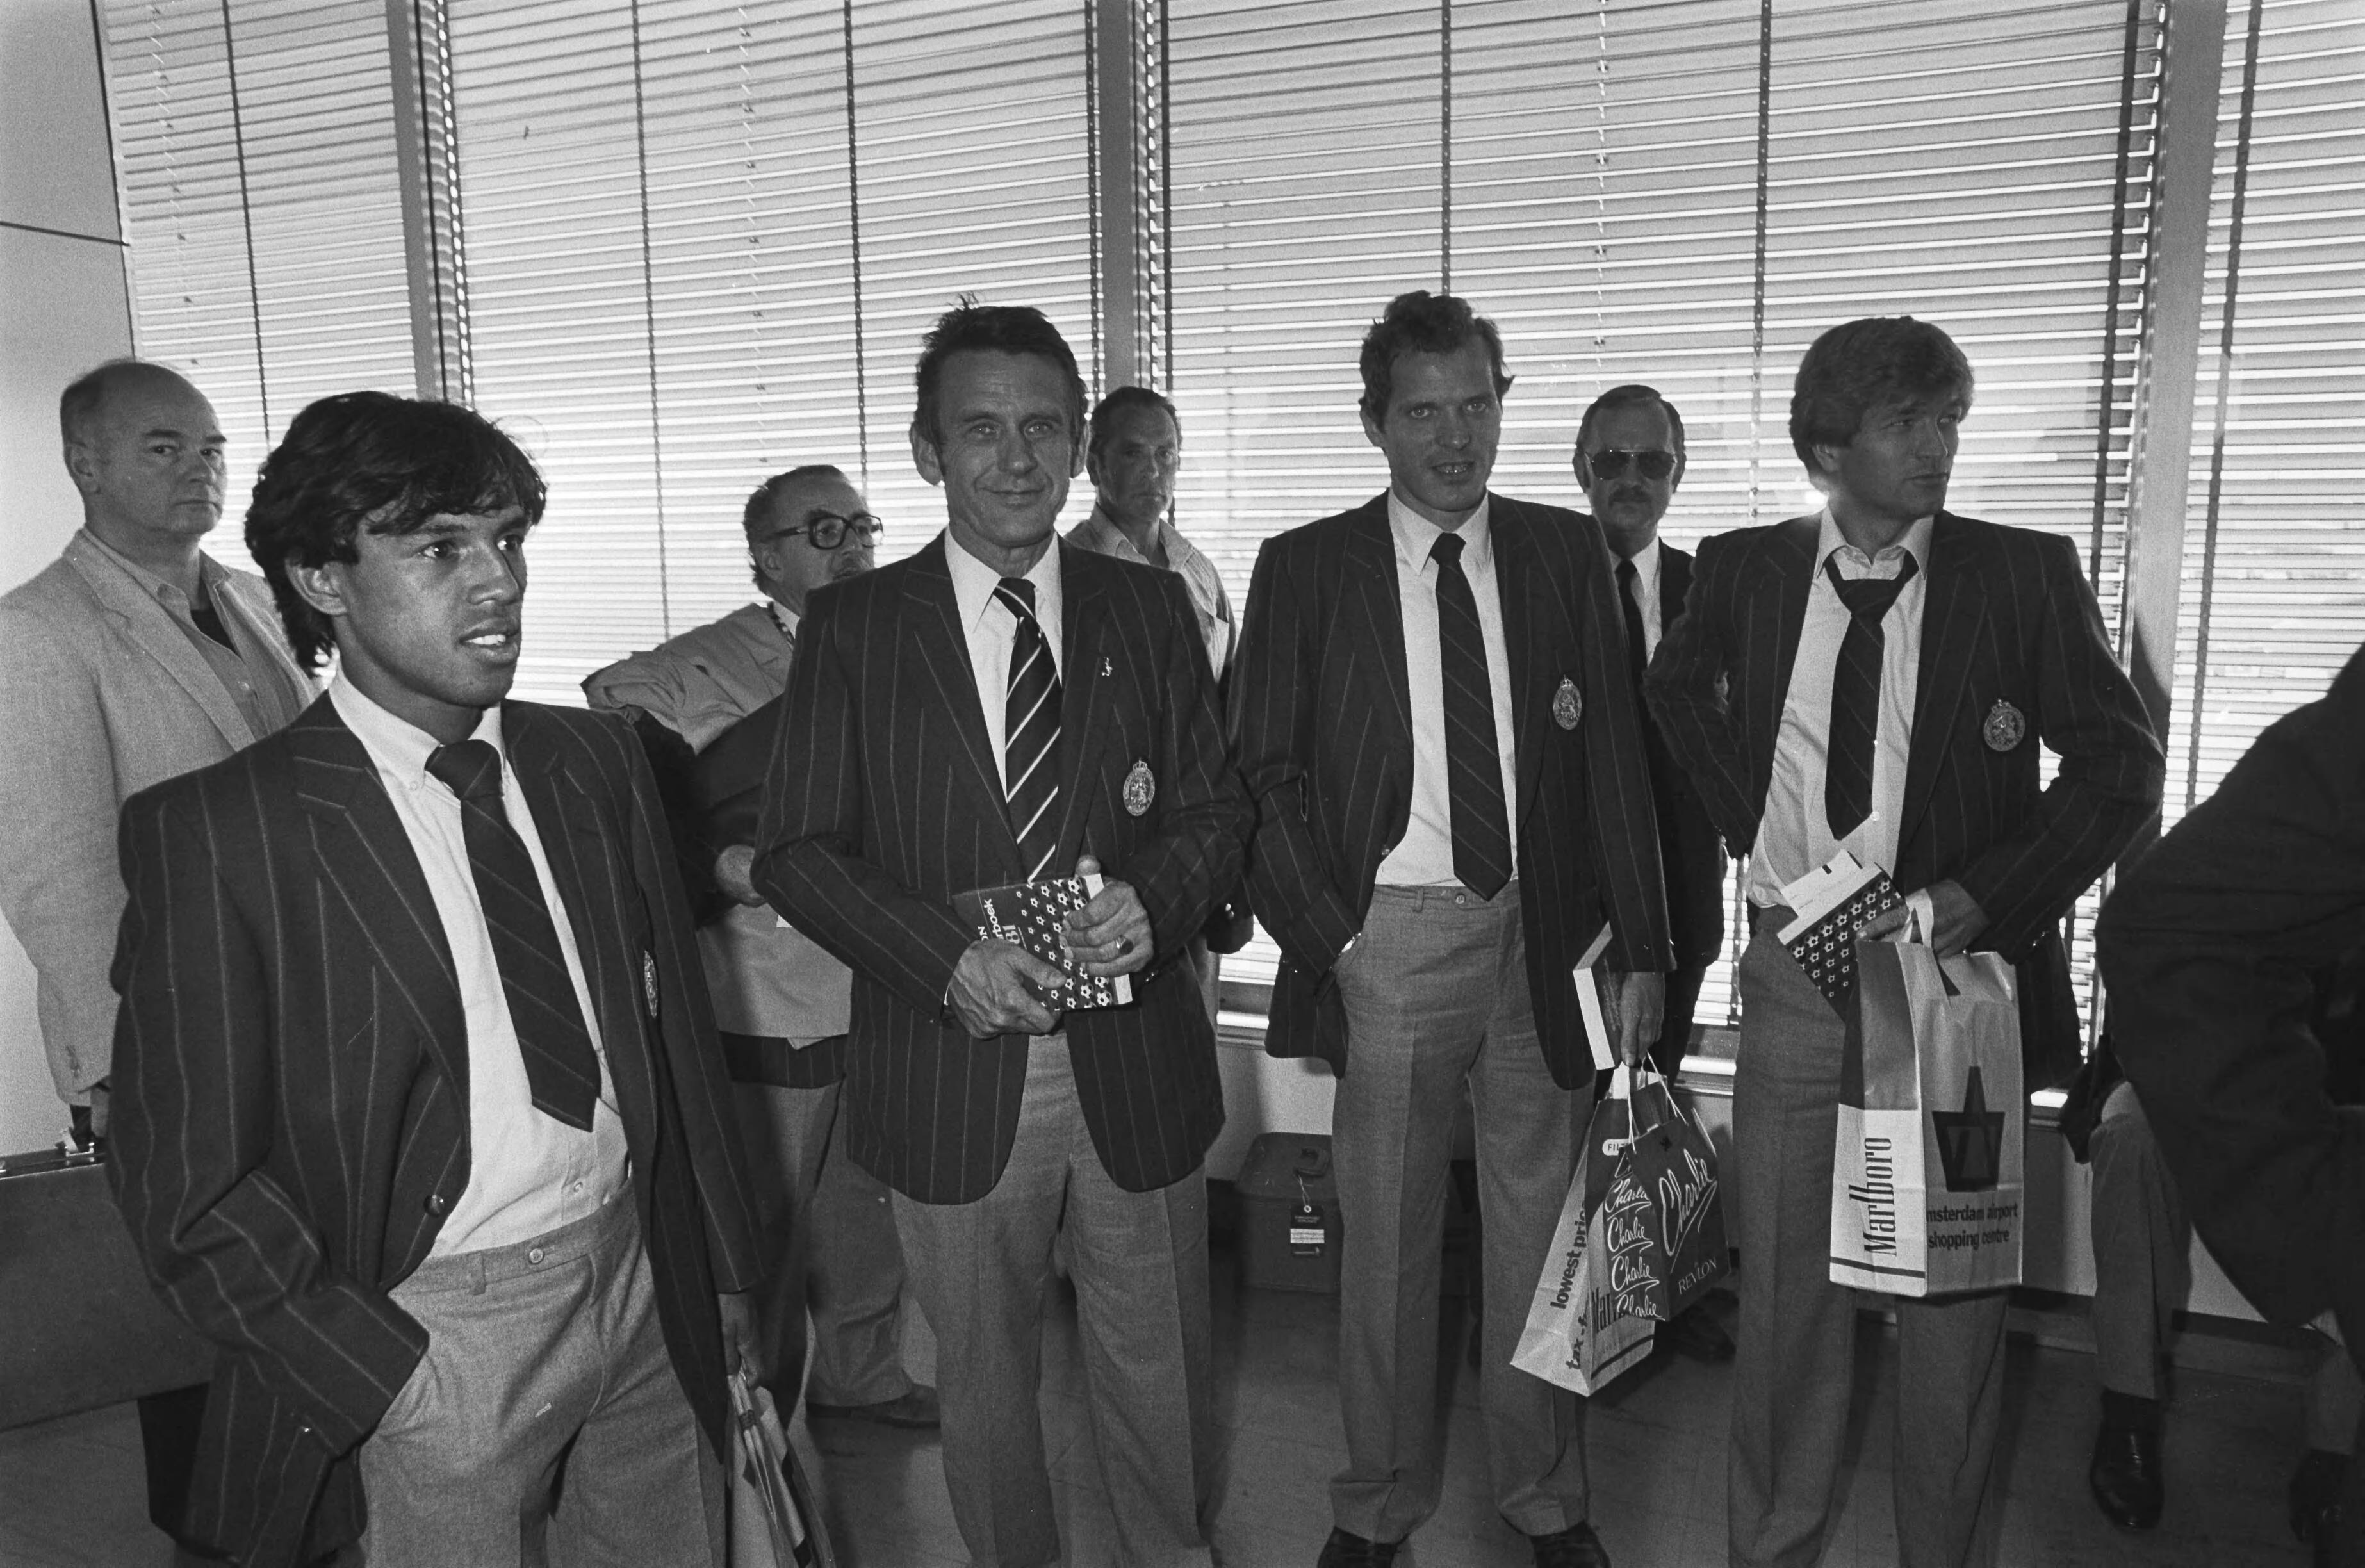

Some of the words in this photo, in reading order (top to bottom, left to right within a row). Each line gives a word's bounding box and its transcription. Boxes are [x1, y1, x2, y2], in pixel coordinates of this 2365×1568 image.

[1658, 1148, 1716, 1257] Charlie
[1848, 1138, 1897, 1257] Marlboro
[1926, 1204, 1985, 1223] msterdam
[1987, 1202, 2018, 1221] airport
[1607, 1216, 1652, 1254] Charlie
[1928, 1230, 1979, 1251] shopping
[1550, 1250, 1582, 1309] lowest
[1611, 1256, 1657, 1291] Charlie
[1678, 1257, 1717, 1295] REVLON
